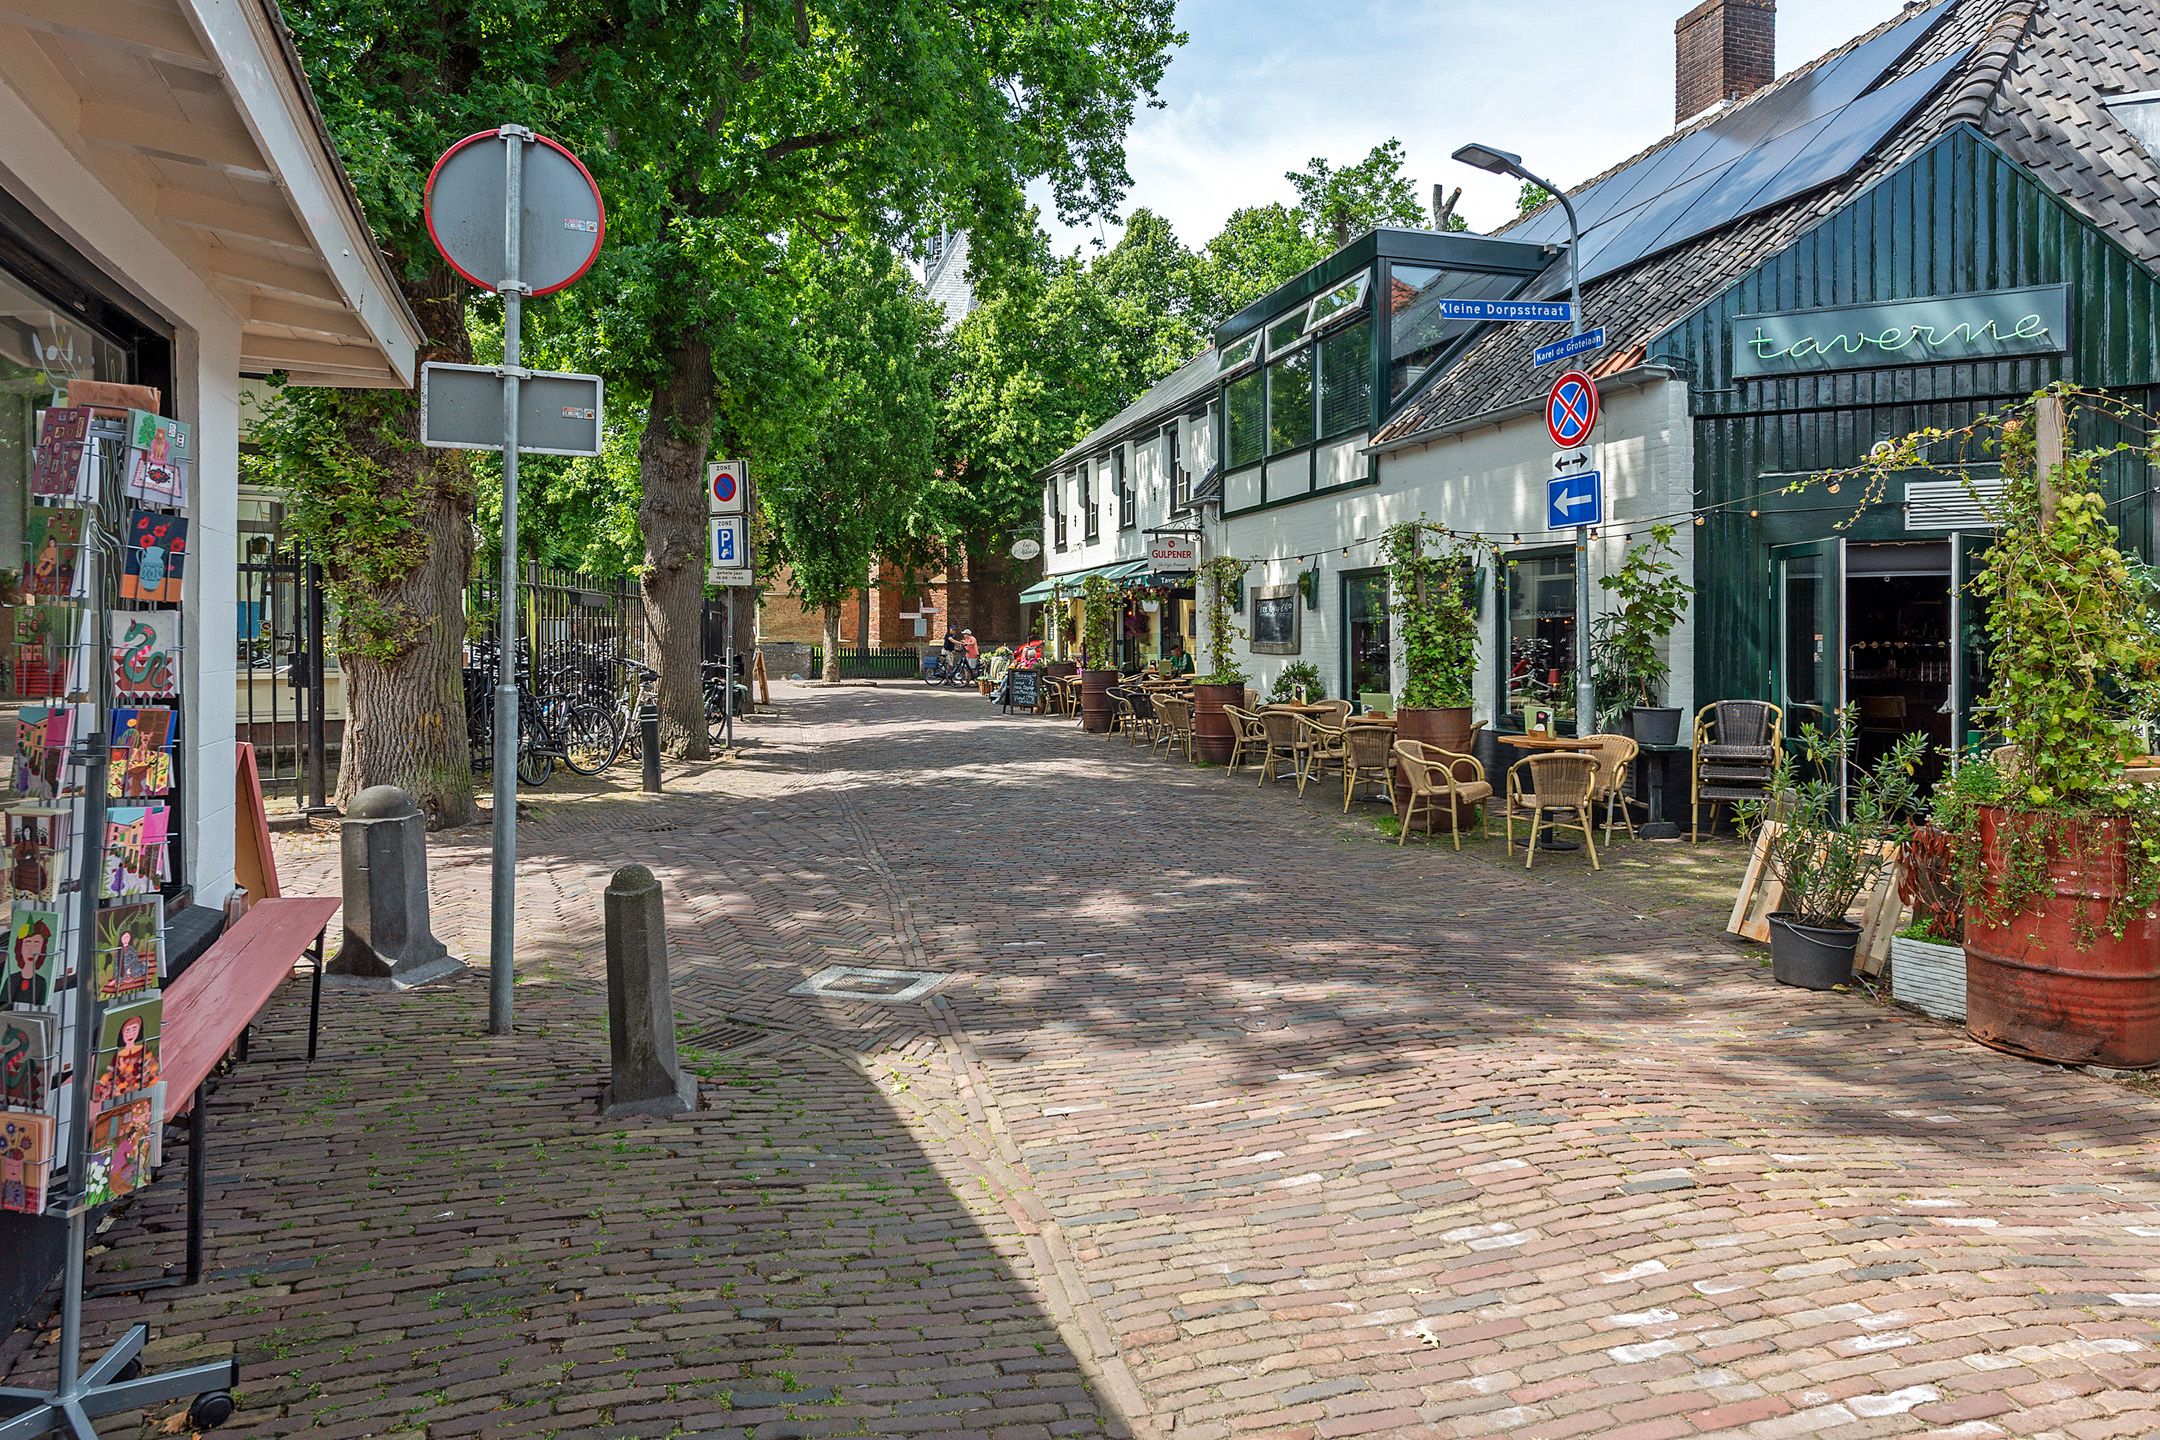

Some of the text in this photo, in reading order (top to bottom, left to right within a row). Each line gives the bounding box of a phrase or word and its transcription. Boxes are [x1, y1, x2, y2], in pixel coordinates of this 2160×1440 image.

[1439, 302, 1564, 318] Kleine Dorpsstraat
[1748, 312, 2050, 360] taverne
[1536, 335, 1601, 362] Karel de Grotelaan
[721, 530, 731, 547] P
[1151, 549, 1192, 559] GULPENER
